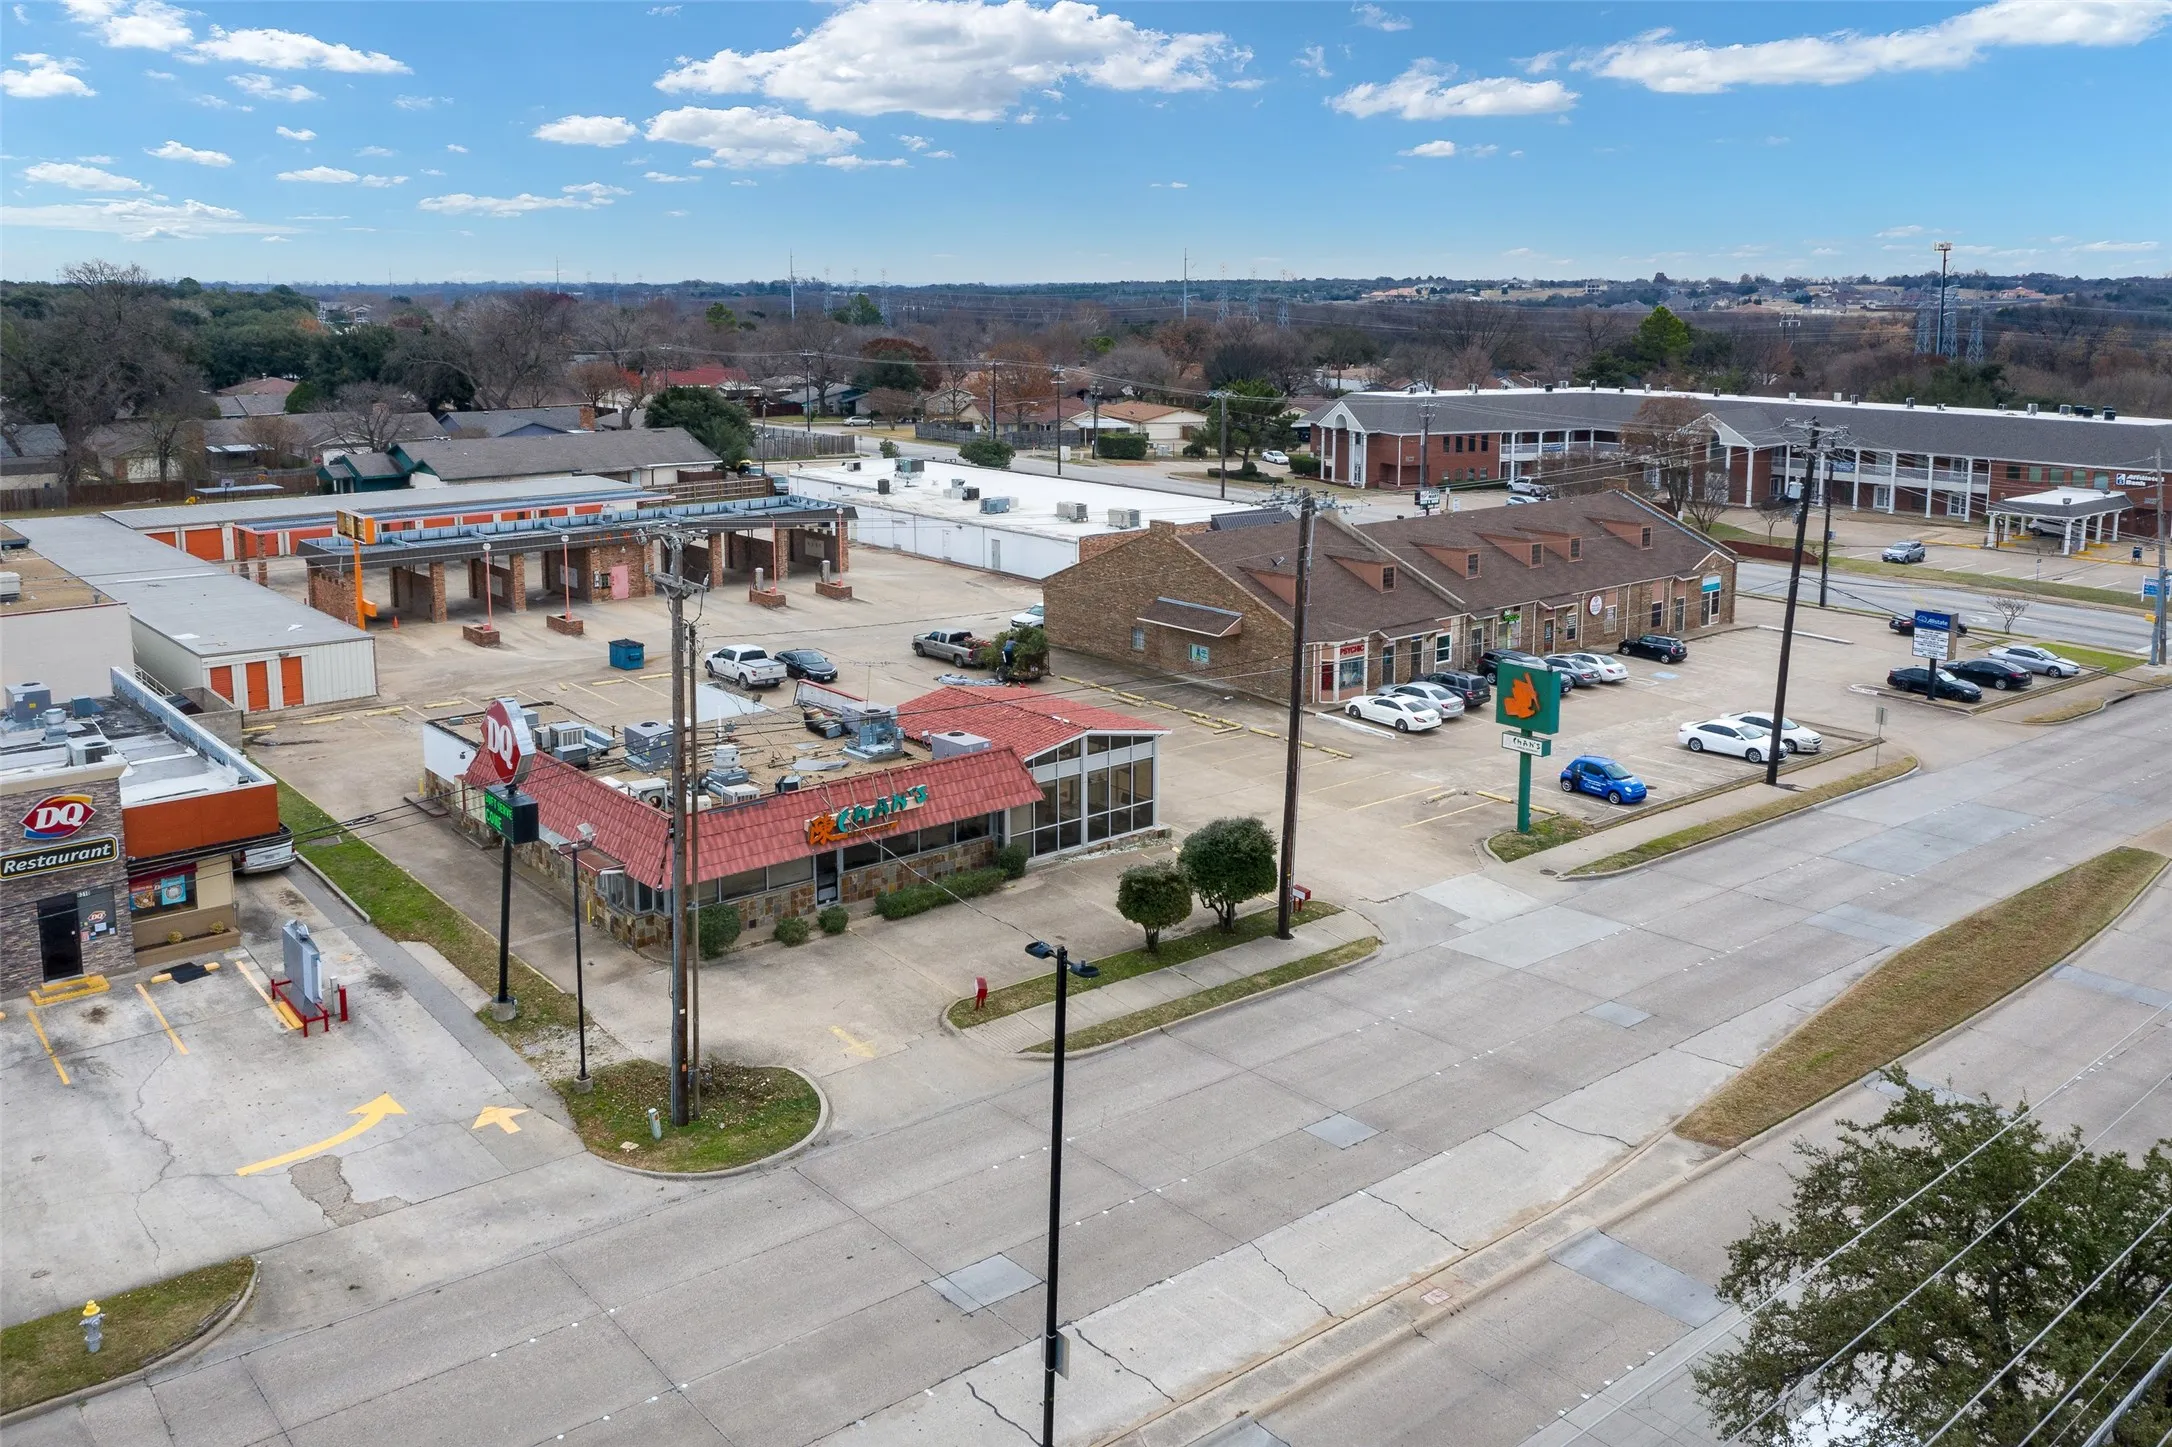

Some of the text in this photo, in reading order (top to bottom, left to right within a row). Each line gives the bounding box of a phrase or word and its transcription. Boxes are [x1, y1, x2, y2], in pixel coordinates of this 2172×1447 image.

[1927, 618, 1949, 627] Allstate
[1340, 644, 1365, 655] PSYCHIC
[487, 715, 513, 770] DQ
[34, 802, 85, 830] DQ
[836, 784, 928, 833] CHAN'S
[3, 843, 112, 874] Restaurant
